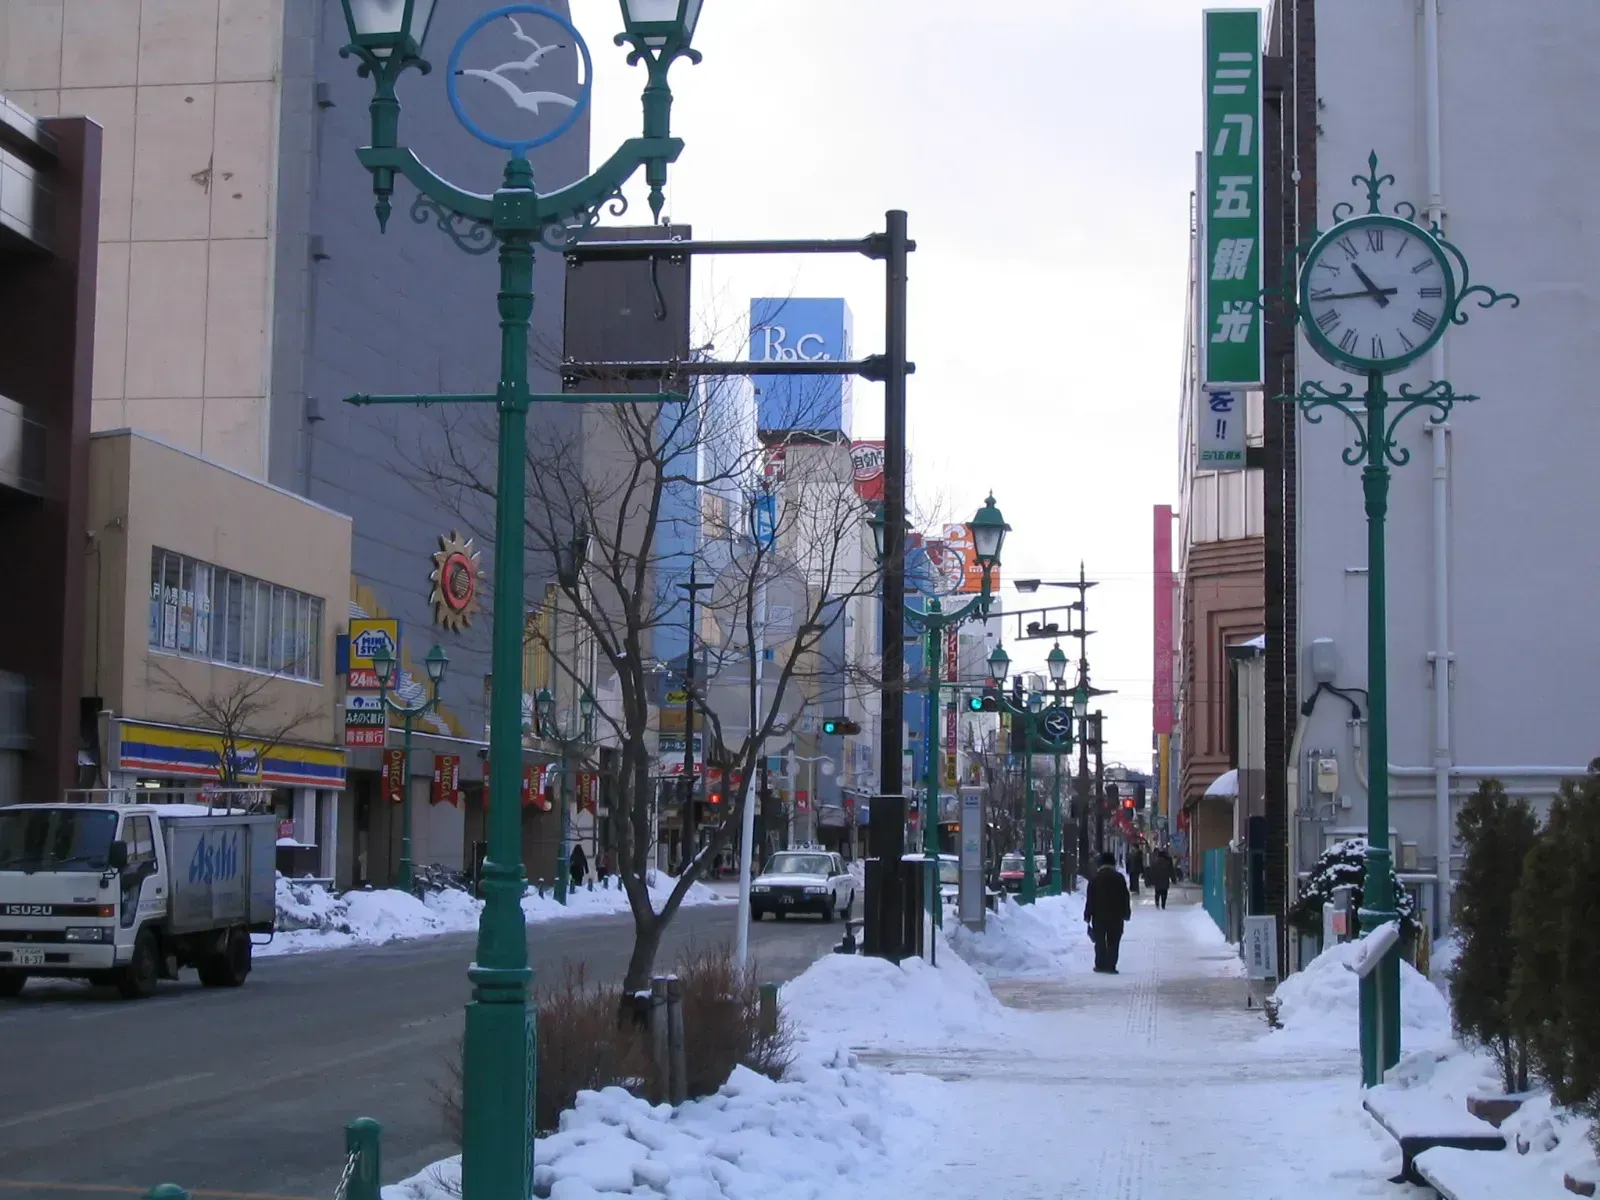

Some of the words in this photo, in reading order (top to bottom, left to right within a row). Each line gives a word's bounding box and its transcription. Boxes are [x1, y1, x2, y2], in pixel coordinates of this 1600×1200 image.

[1211, 52, 1253, 343] 三八五観光
[1366, 229, 1384, 254] XII
[1417, 287, 1443, 299] III
[389, 750, 402, 793] OMEGA
[440, 756, 452, 798] OMEGA
[188, 830, 237, 885] Asahi
[6, 905, 53, 915] ISUZU
